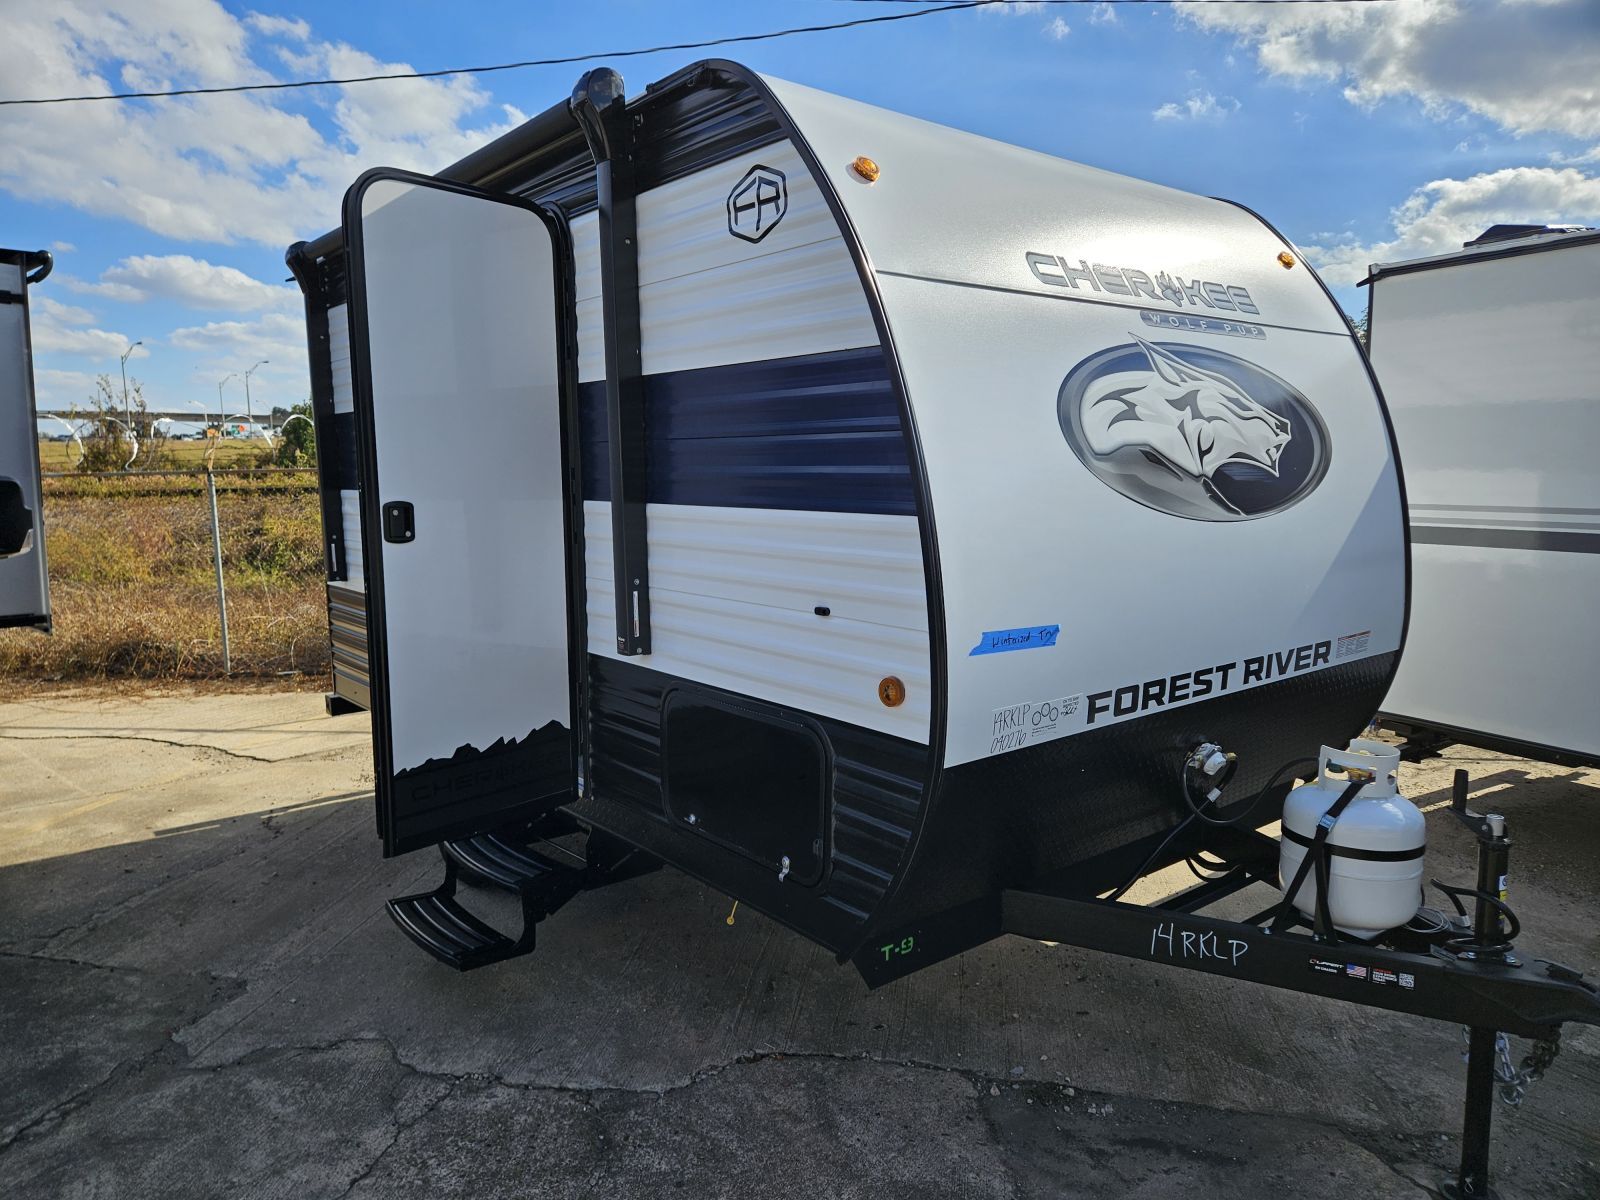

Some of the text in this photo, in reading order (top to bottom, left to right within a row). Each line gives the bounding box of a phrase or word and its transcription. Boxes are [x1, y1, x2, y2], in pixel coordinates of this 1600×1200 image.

[1025, 251, 1260, 315] CHEROKEE
[1149, 313, 1259, 336] WOLF PUP
[1086, 662, 1236, 725] FOREST
[1243, 640, 1332, 685] RIVER
